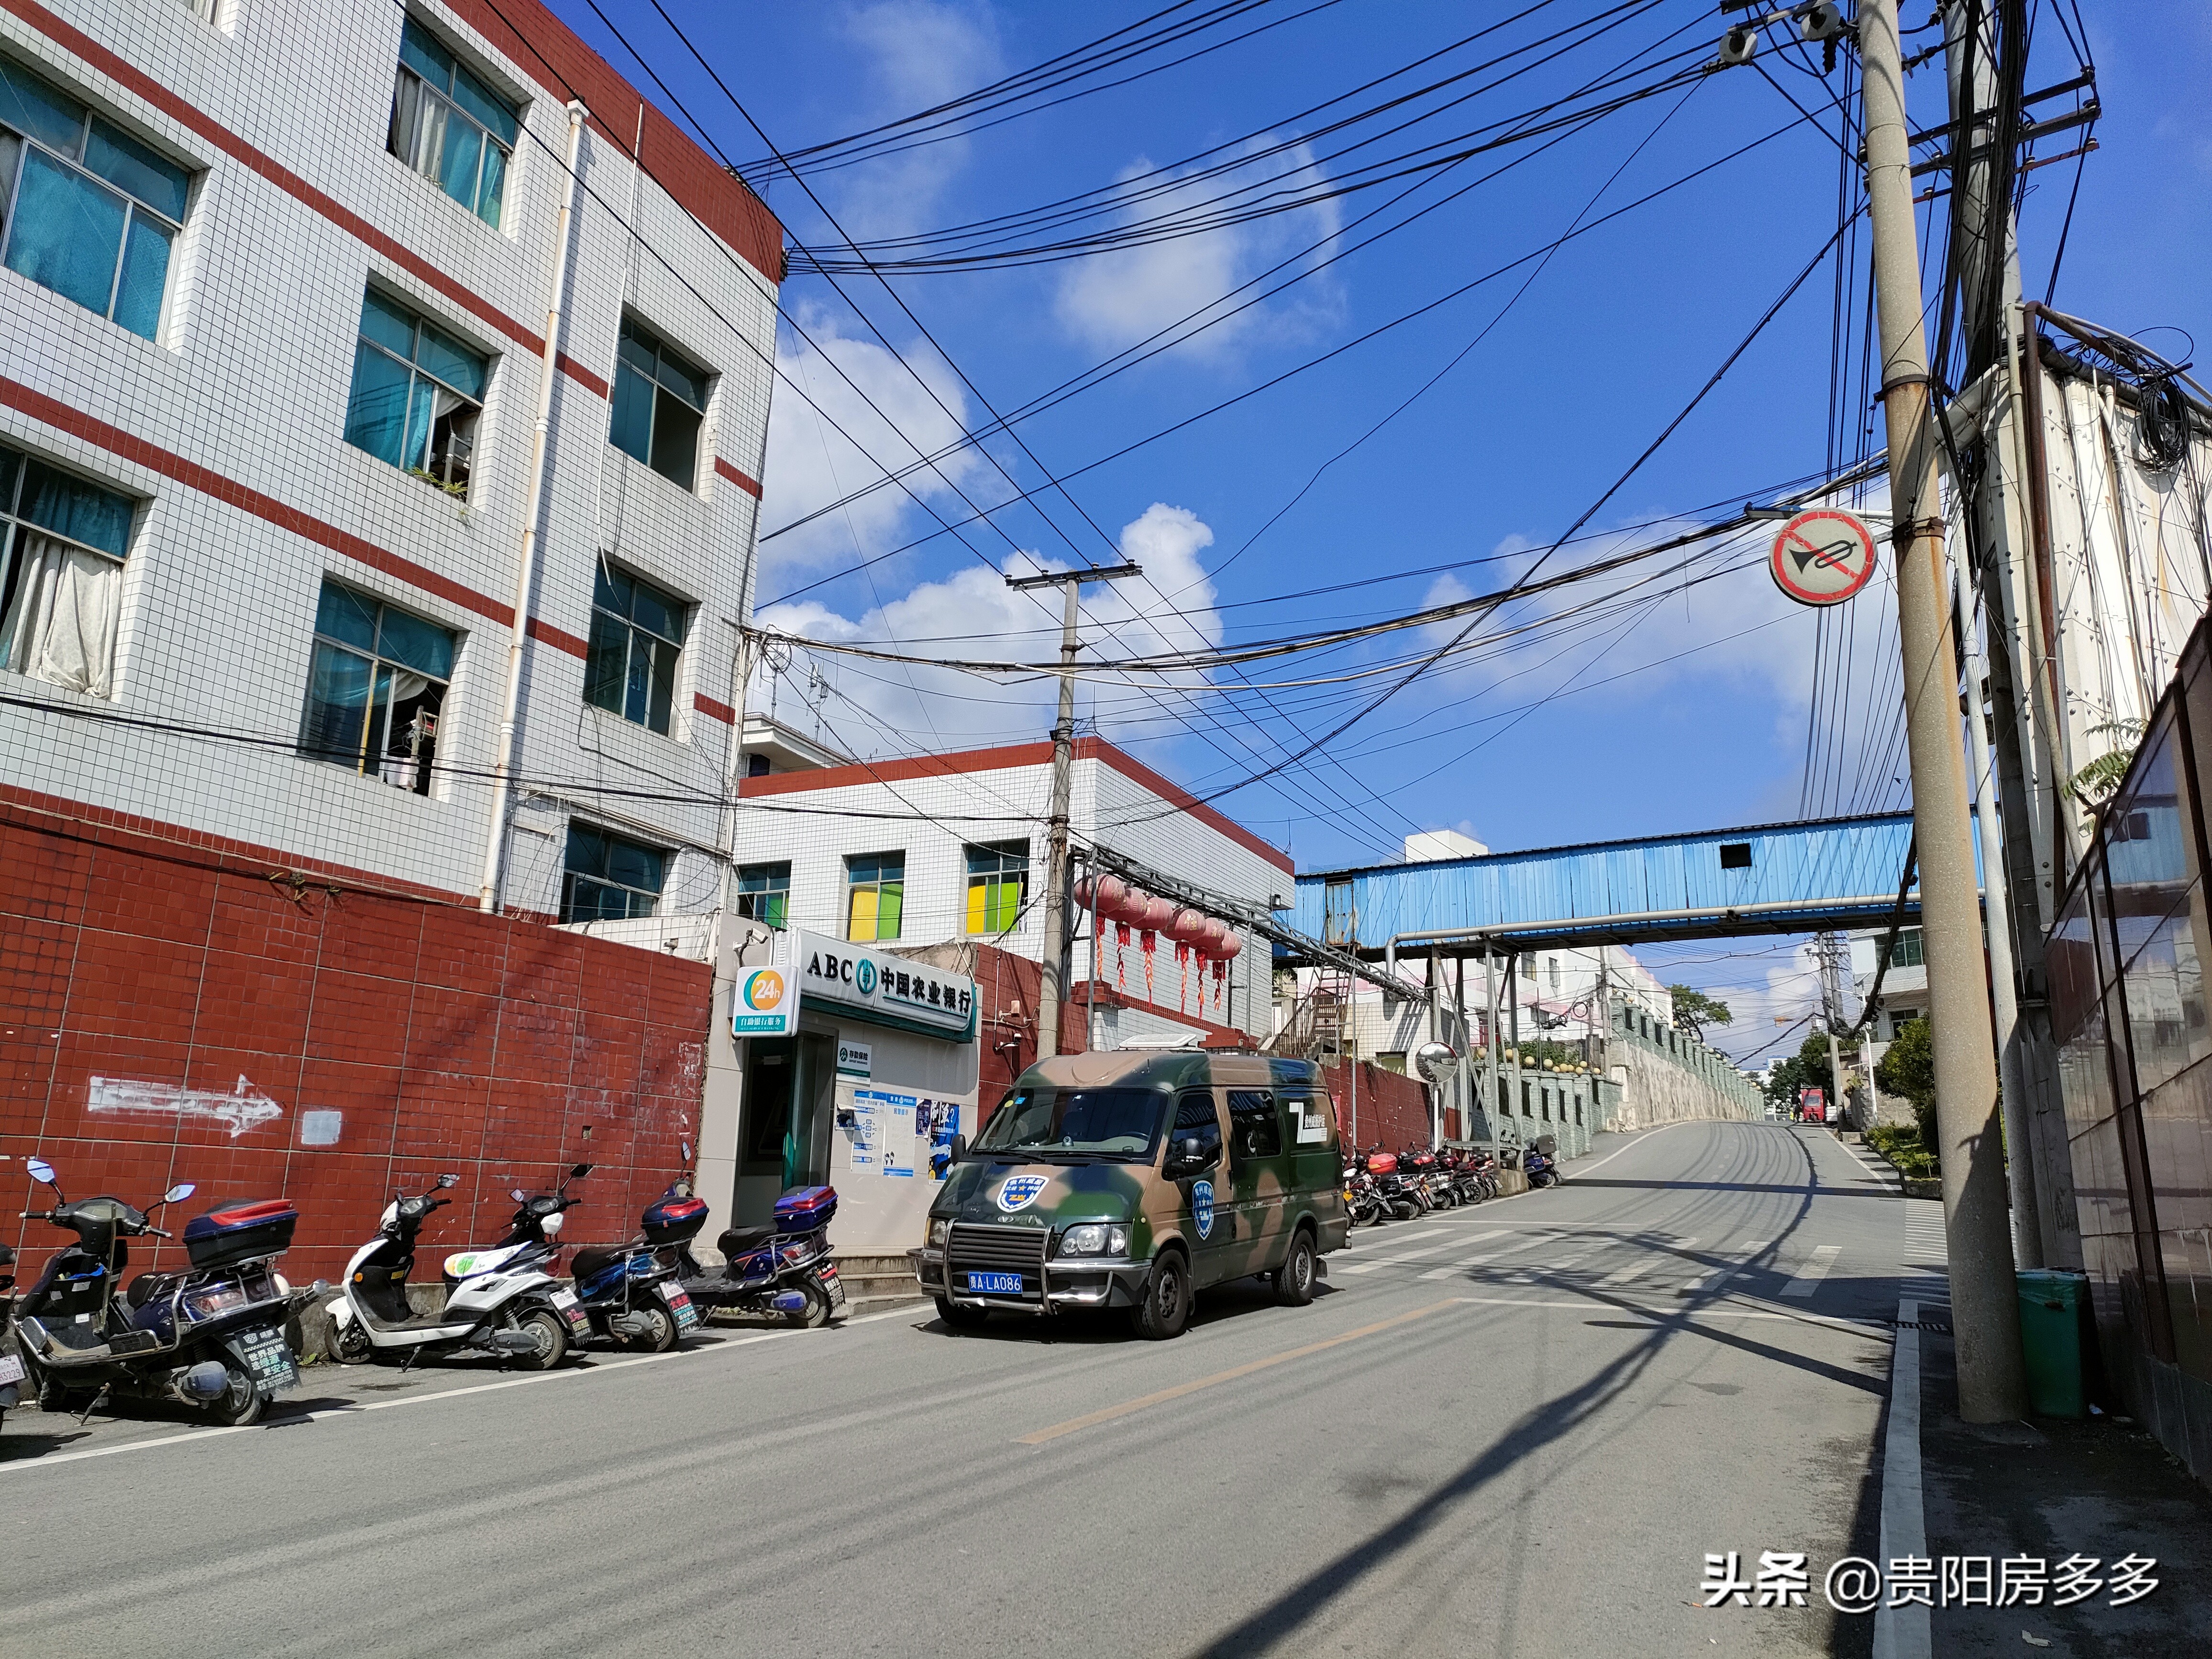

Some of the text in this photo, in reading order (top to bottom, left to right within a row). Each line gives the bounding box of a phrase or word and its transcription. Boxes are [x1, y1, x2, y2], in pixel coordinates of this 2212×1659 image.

[807, 951, 852, 982] ABC
[755, 980, 780, 998] 24h
[881, 966, 971, 1013] 中国农业银行
[741, 1017, 781, 1026] 自助银行服务
[849, 1050, 868, 1061] 存款保险
[970, 1275, 1020, 1291] 贵A·LA086
[248, 1344, 285, 1361] 世界品牌
[251, 1354, 280, 1371] 选绿源
[262, 1361, 291, 1377] 更安全
